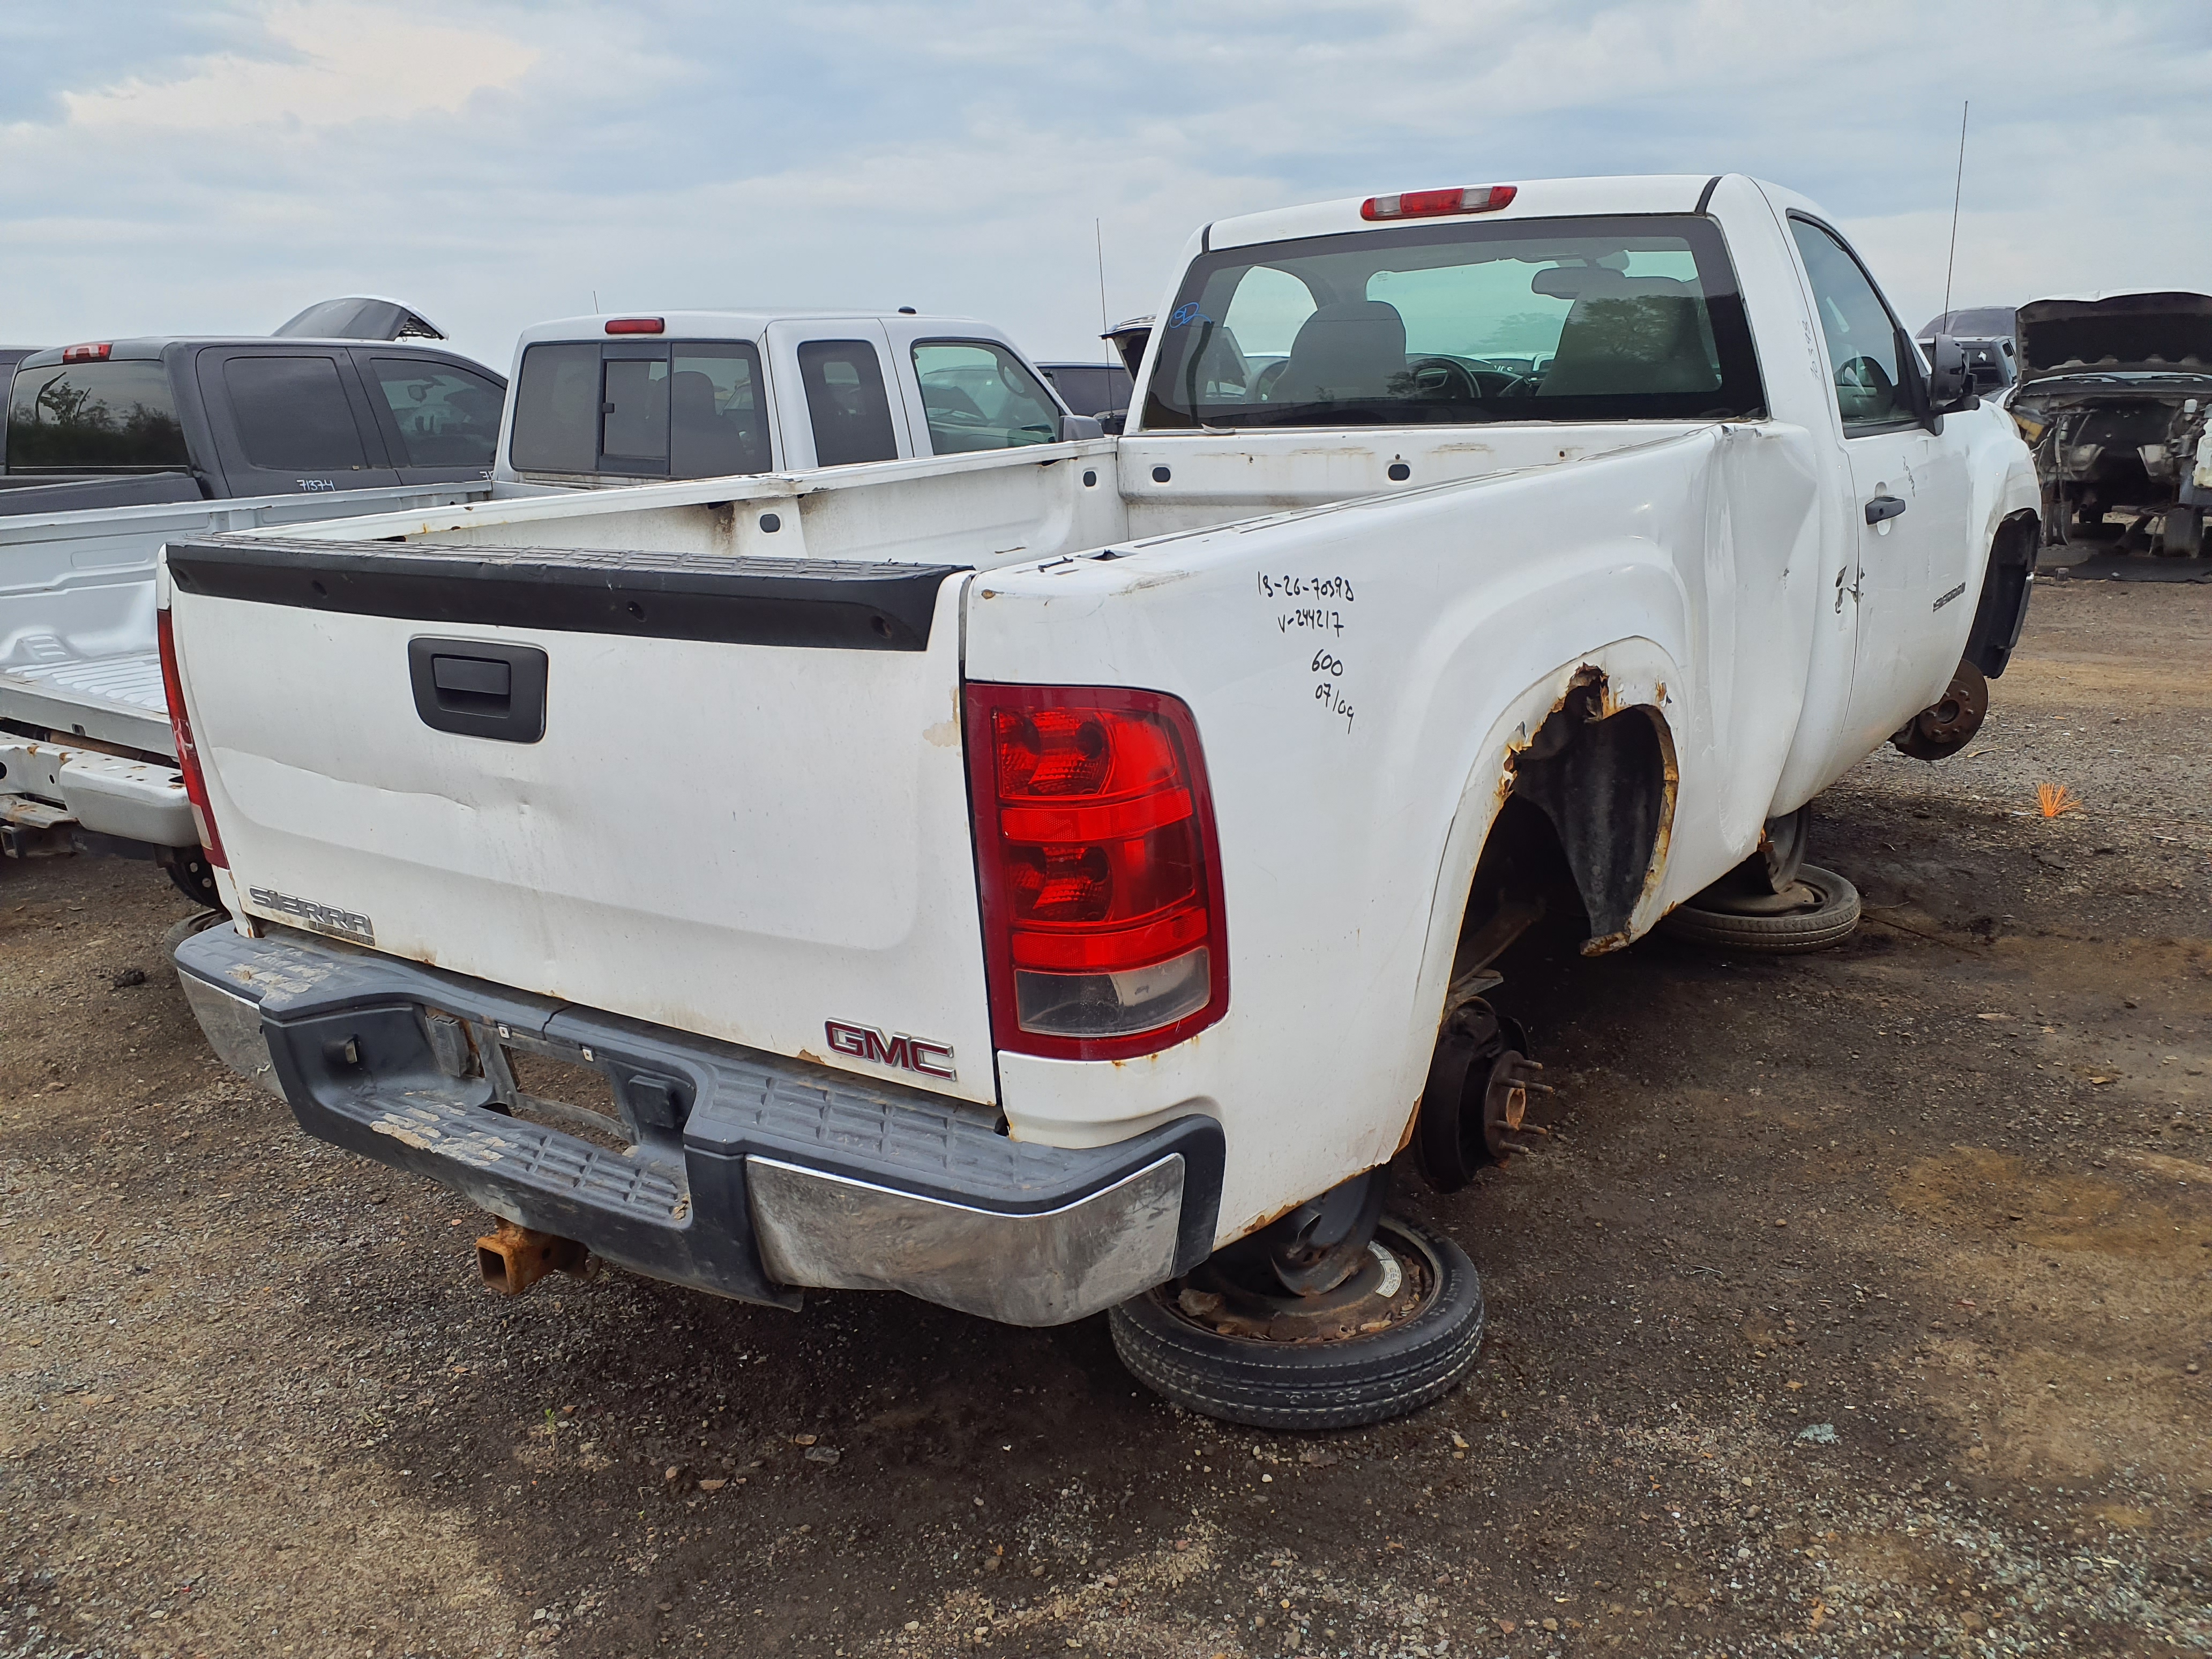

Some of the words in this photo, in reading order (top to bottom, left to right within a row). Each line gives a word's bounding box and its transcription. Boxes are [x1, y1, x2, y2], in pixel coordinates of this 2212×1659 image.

[1311, 648, 1343, 677] 600
[249, 885, 373, 936] SIERRA
[825, 1016, 956, 1081] GMC
